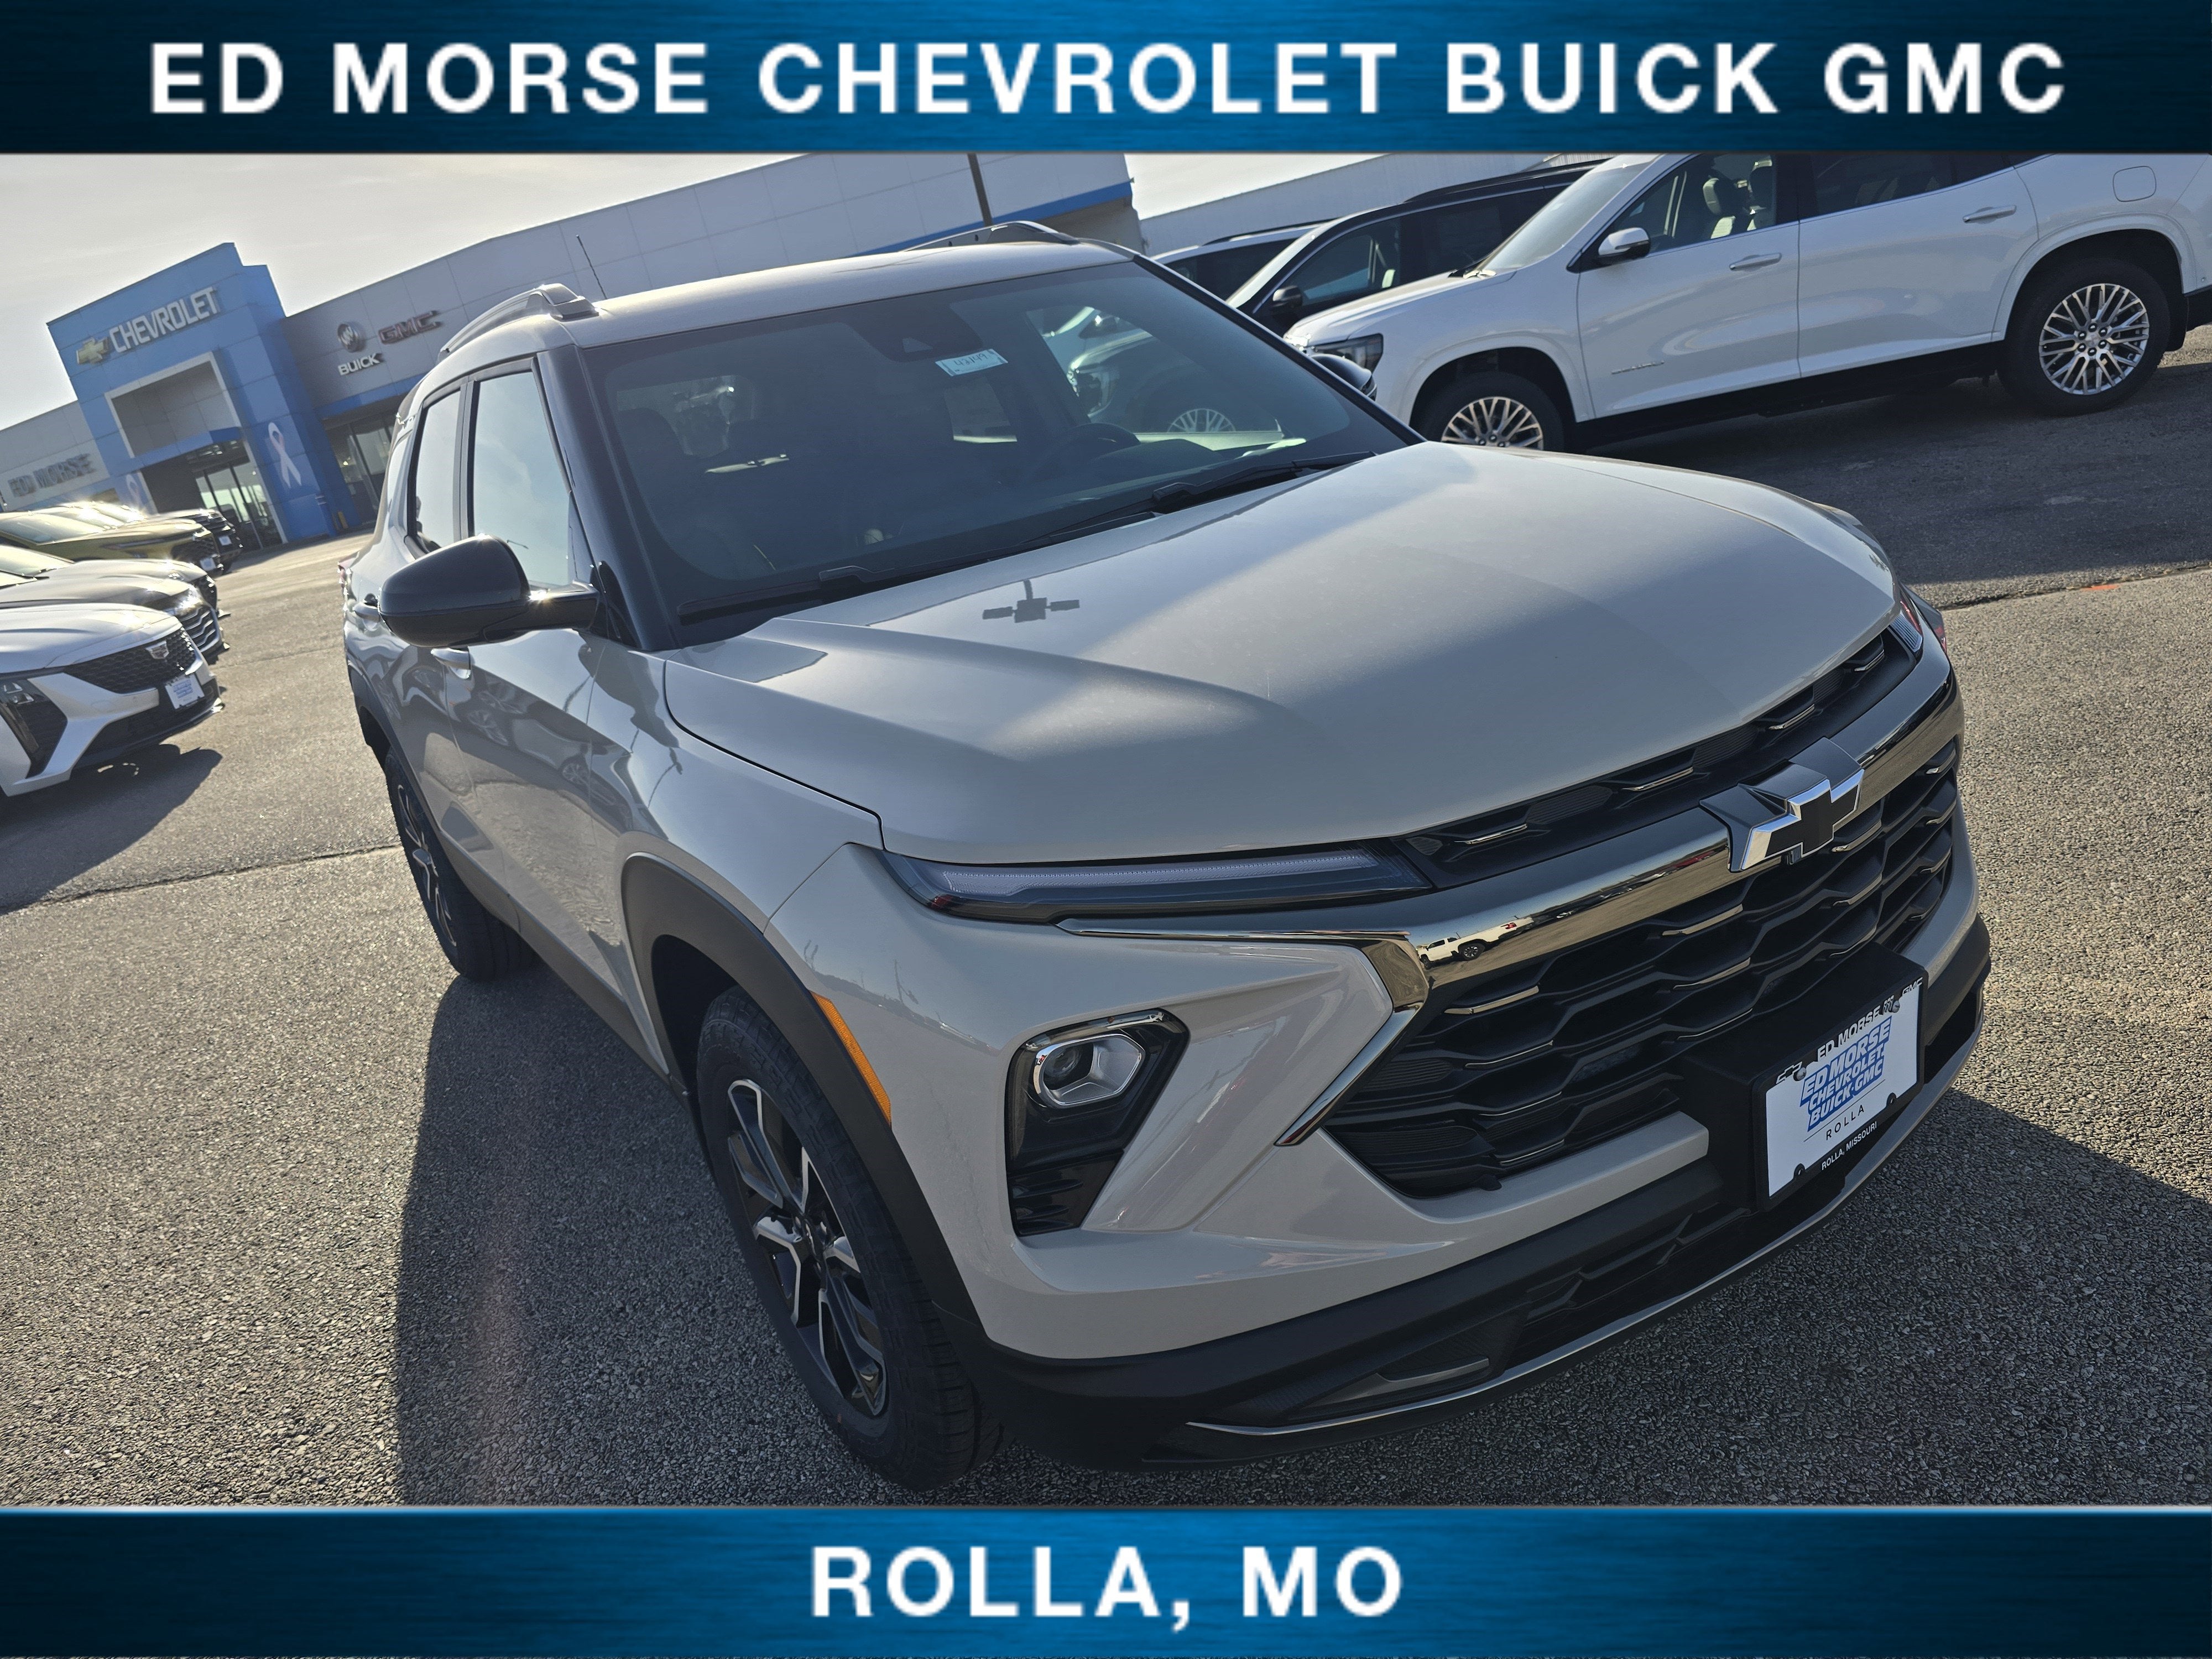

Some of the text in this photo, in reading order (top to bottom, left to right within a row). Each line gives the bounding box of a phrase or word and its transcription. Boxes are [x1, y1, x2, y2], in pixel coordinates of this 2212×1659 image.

[109, 286, 217, 353] CHEVROLET
[378, 311, 440, 345] GMC
[338, 353, 380, 375] BUICK
[1902, 977, 1923, 995] GMC
[1817, 1005, 1881, 1062] ED MORSE
[1801, 1017, 1891, 1102] ED MORSE
[1808, 1043, 1885, 1111] CHEVROLET
[1822, 1121, 1877, 1171] ROLLA, MISSOURI
[1826, 1105, 1864, 1140] ROLLA
